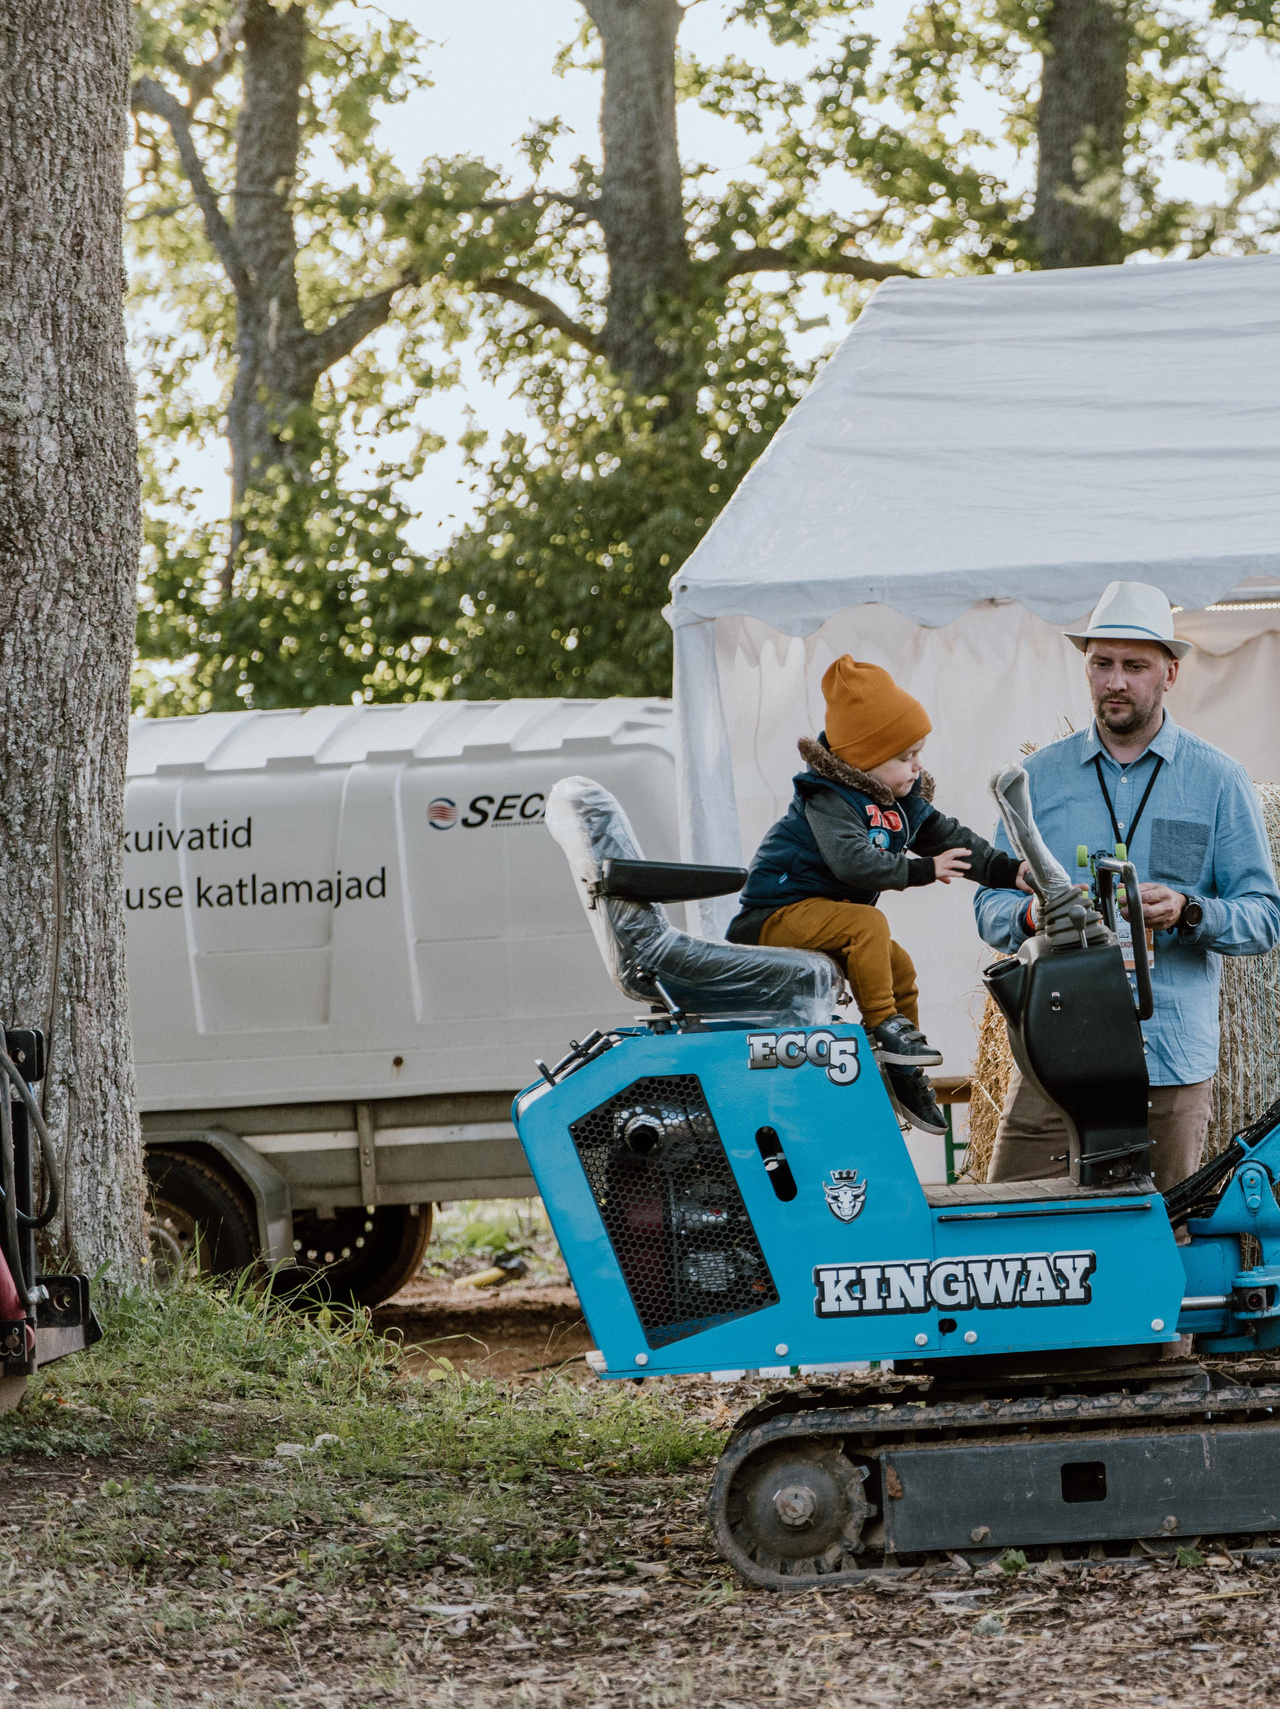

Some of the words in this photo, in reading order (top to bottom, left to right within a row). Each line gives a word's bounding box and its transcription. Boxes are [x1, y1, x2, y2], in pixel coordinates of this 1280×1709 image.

[461, 793, 547, 828] SEC
[196, 866, 387, 908] katlamajad
[815, 1252, 1096, 1318] KINGWAY
